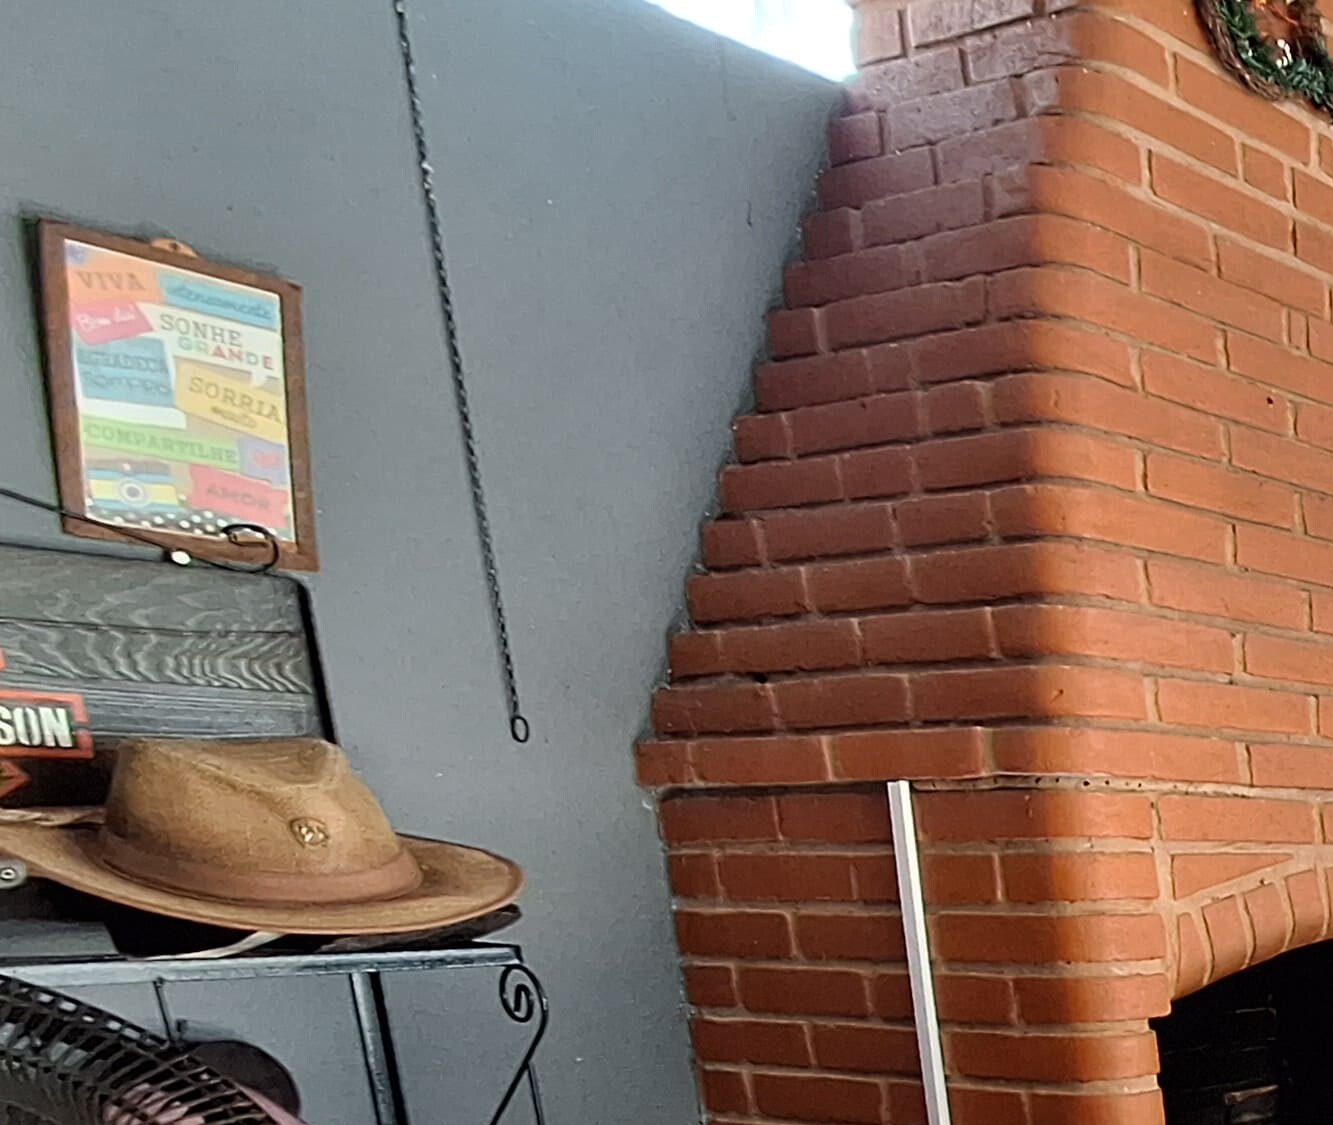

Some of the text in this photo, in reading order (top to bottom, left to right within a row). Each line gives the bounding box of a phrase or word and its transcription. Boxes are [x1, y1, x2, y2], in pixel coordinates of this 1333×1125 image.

[76, 270, 147, 291] VIVA
[159, 313, 243, 348] SONHE
[178, 336, 275, 370] GRANDE
[188, 376, 283, 425] SORRIA
[86, 423, 237, 464] COMPARTILHE
[0, 705, 73, 748] SON
